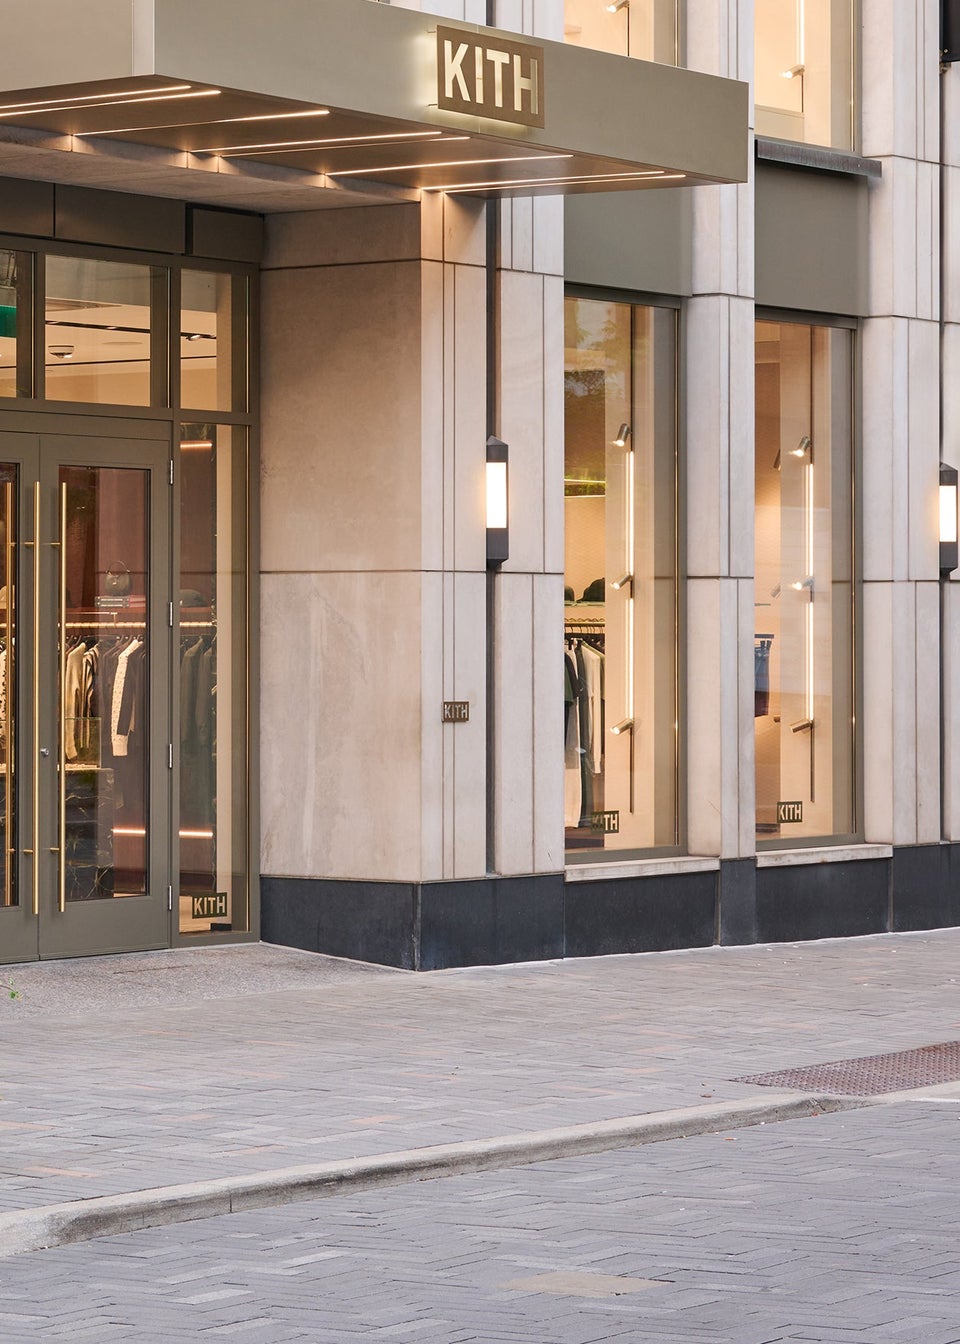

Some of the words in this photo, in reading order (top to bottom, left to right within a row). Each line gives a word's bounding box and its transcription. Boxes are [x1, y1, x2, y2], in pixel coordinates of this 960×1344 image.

[444, 39, 539, 115] KITH
[444, 703, 468, 719] KITH
[778, 804, 802, 821] KITH
[193, 895, 226, 915] KITH
